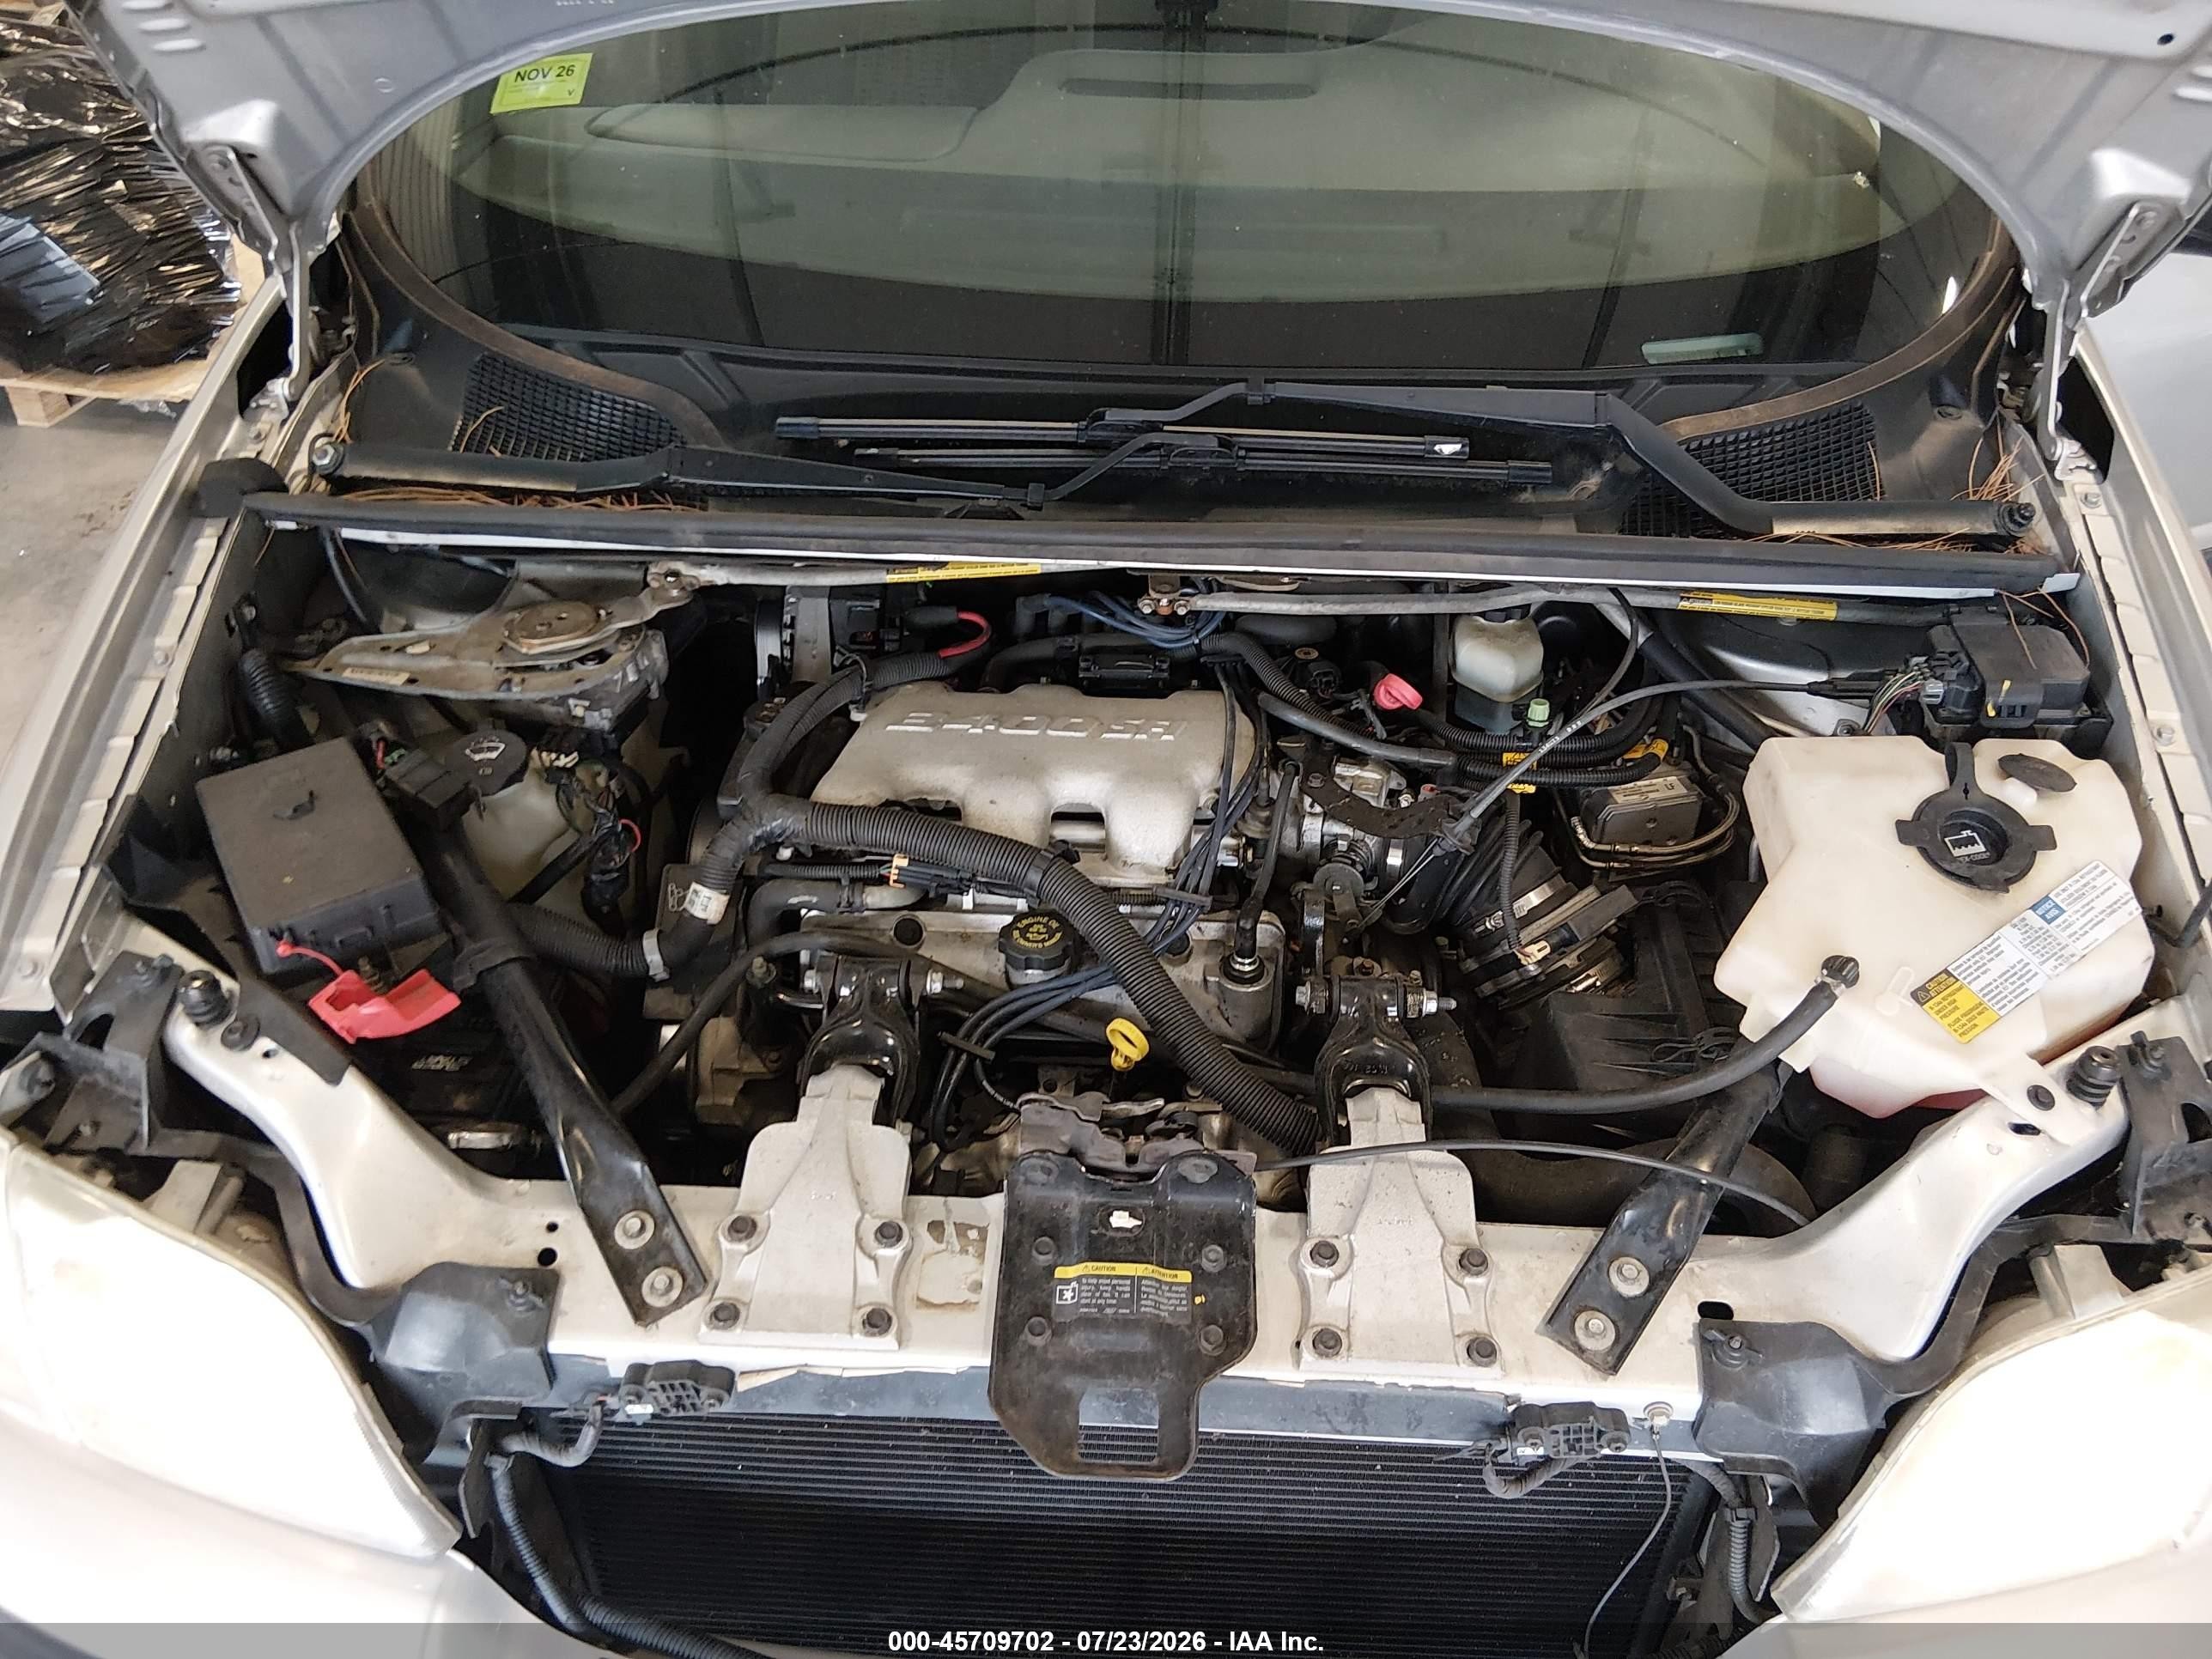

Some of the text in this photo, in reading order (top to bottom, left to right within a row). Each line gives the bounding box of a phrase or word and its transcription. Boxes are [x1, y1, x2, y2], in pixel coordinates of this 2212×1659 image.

[514, 64, 576, 82] NOV 26
[1151, 1268, 1178, 1279] ATTENTION
